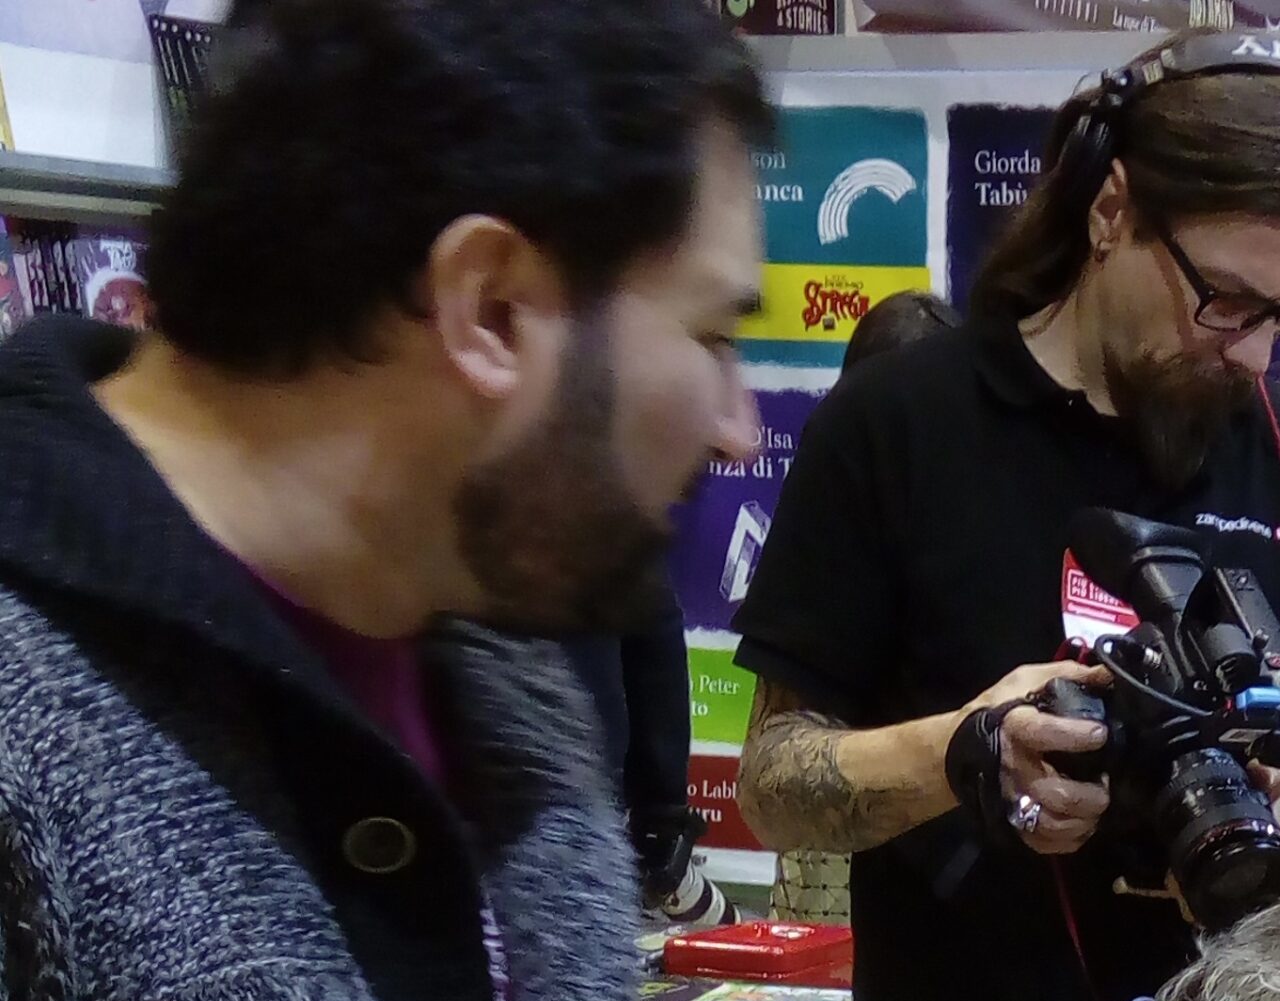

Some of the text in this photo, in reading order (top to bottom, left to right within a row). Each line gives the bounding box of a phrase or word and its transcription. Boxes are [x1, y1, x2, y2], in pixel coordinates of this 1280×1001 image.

[974, 149, 1042, 175] Giorda
[752, 454, 774, 479] di
[699, 674, 741, 695] Peter
